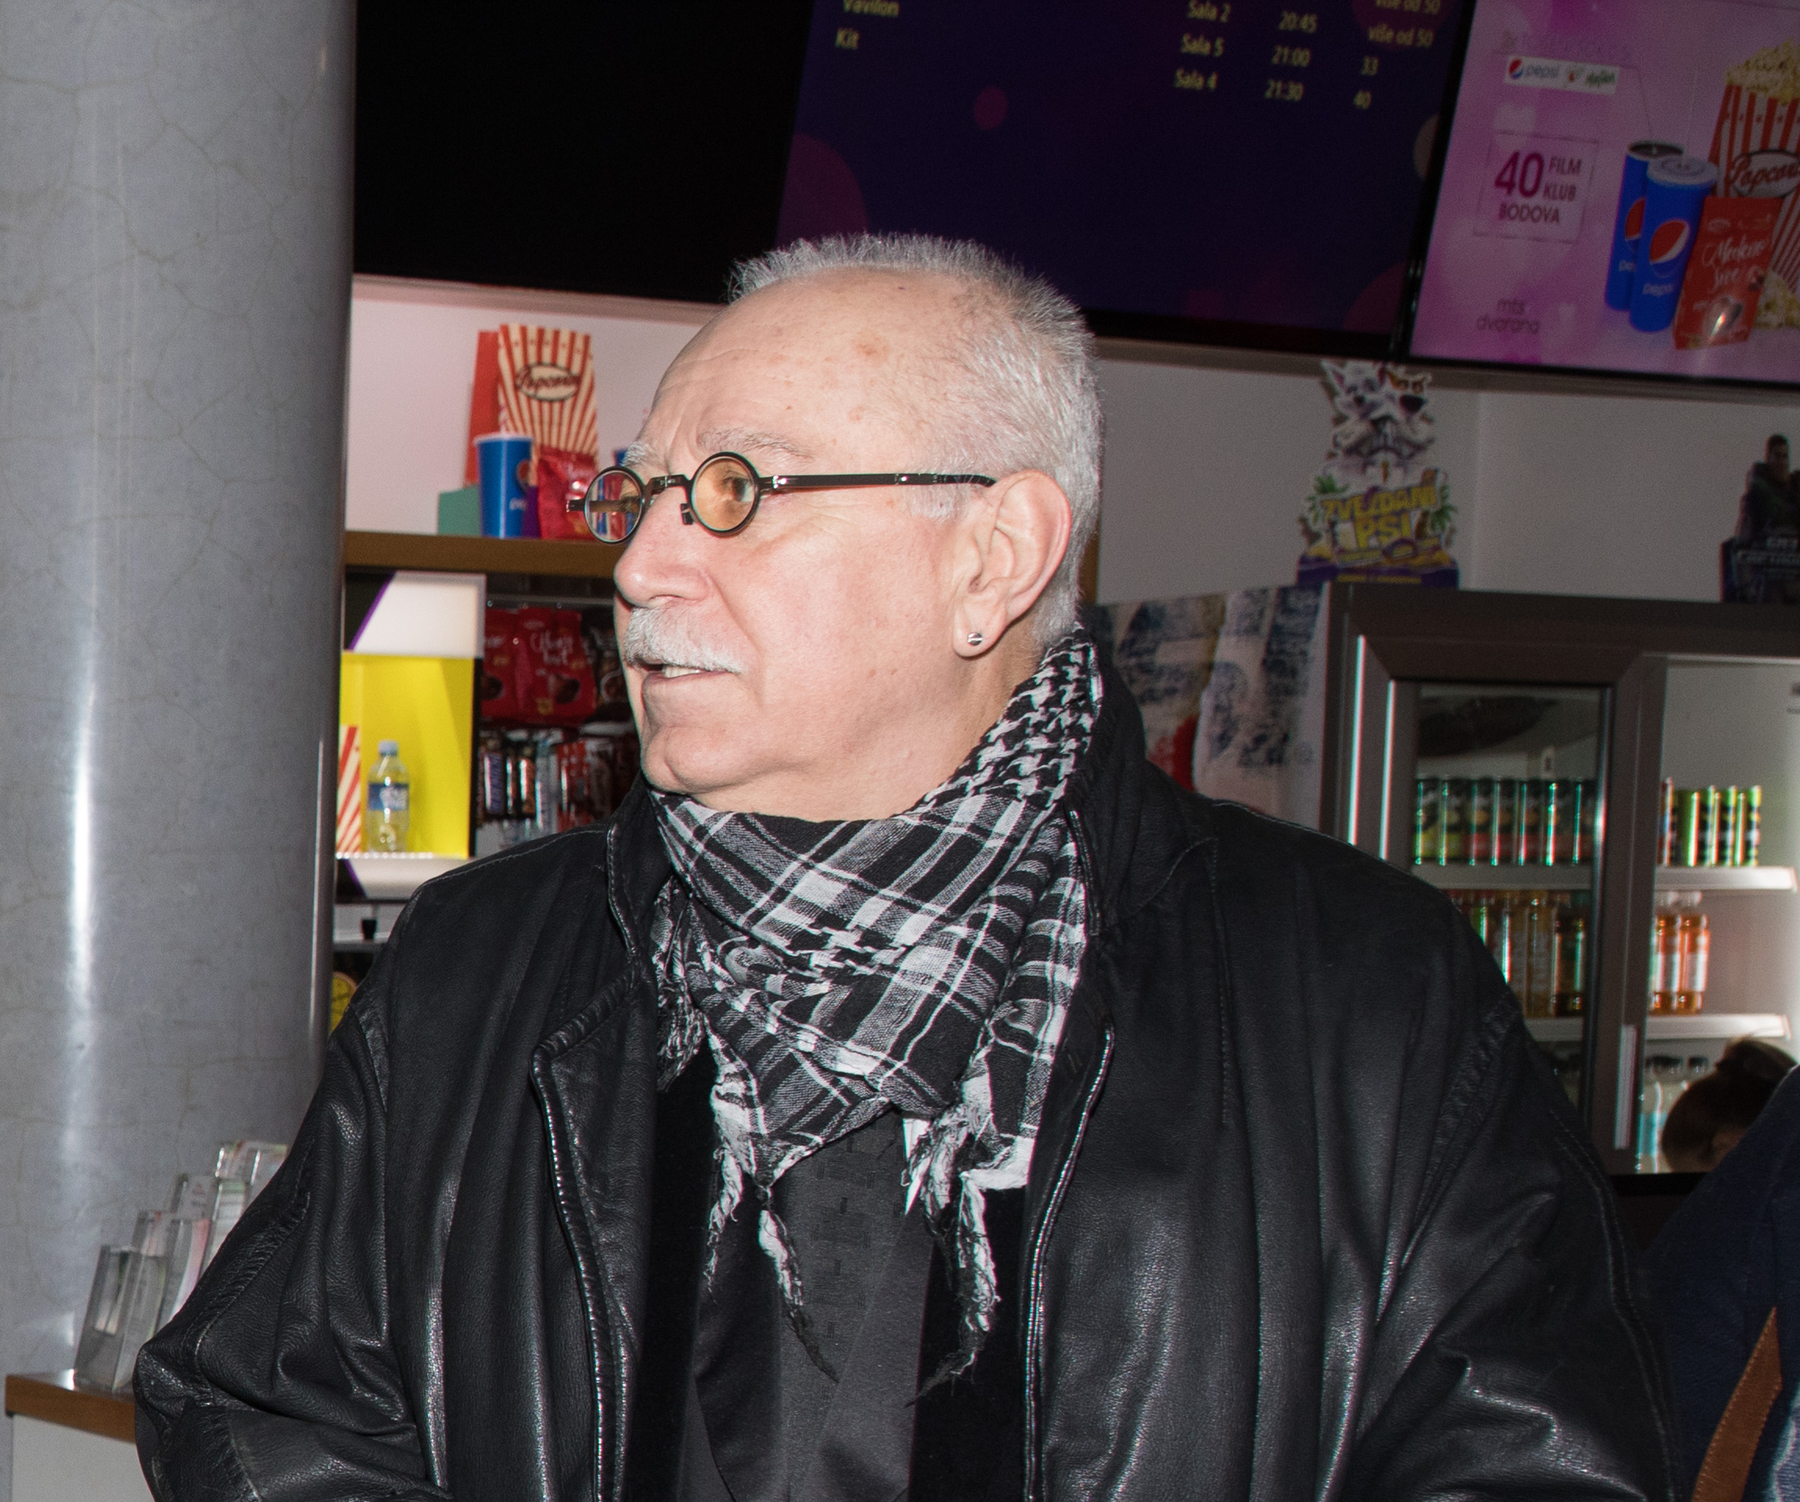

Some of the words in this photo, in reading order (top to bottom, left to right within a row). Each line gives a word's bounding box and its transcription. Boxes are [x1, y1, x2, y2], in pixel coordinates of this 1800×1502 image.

[1220, 1, 1231, 23] 2
[1279, 10, 1319, 34] 20:45
[1181, 33, 1212, 56] Sala
[1396, 27, 1415, 47] od
[1416, 28, 1434, 49] 50
[1271, 44, 1312, 68] 21:00
[1174, 68, 1205, 91] Sala
[1264, 78, 1305, 102] 21:30
[1494, 150, 1545, 198] 40
[1548, 155, 1582, 177] FILM
[1543, 181, 1577, 203] KLUB
[1498, 201, 1561, 226] BODOVA
